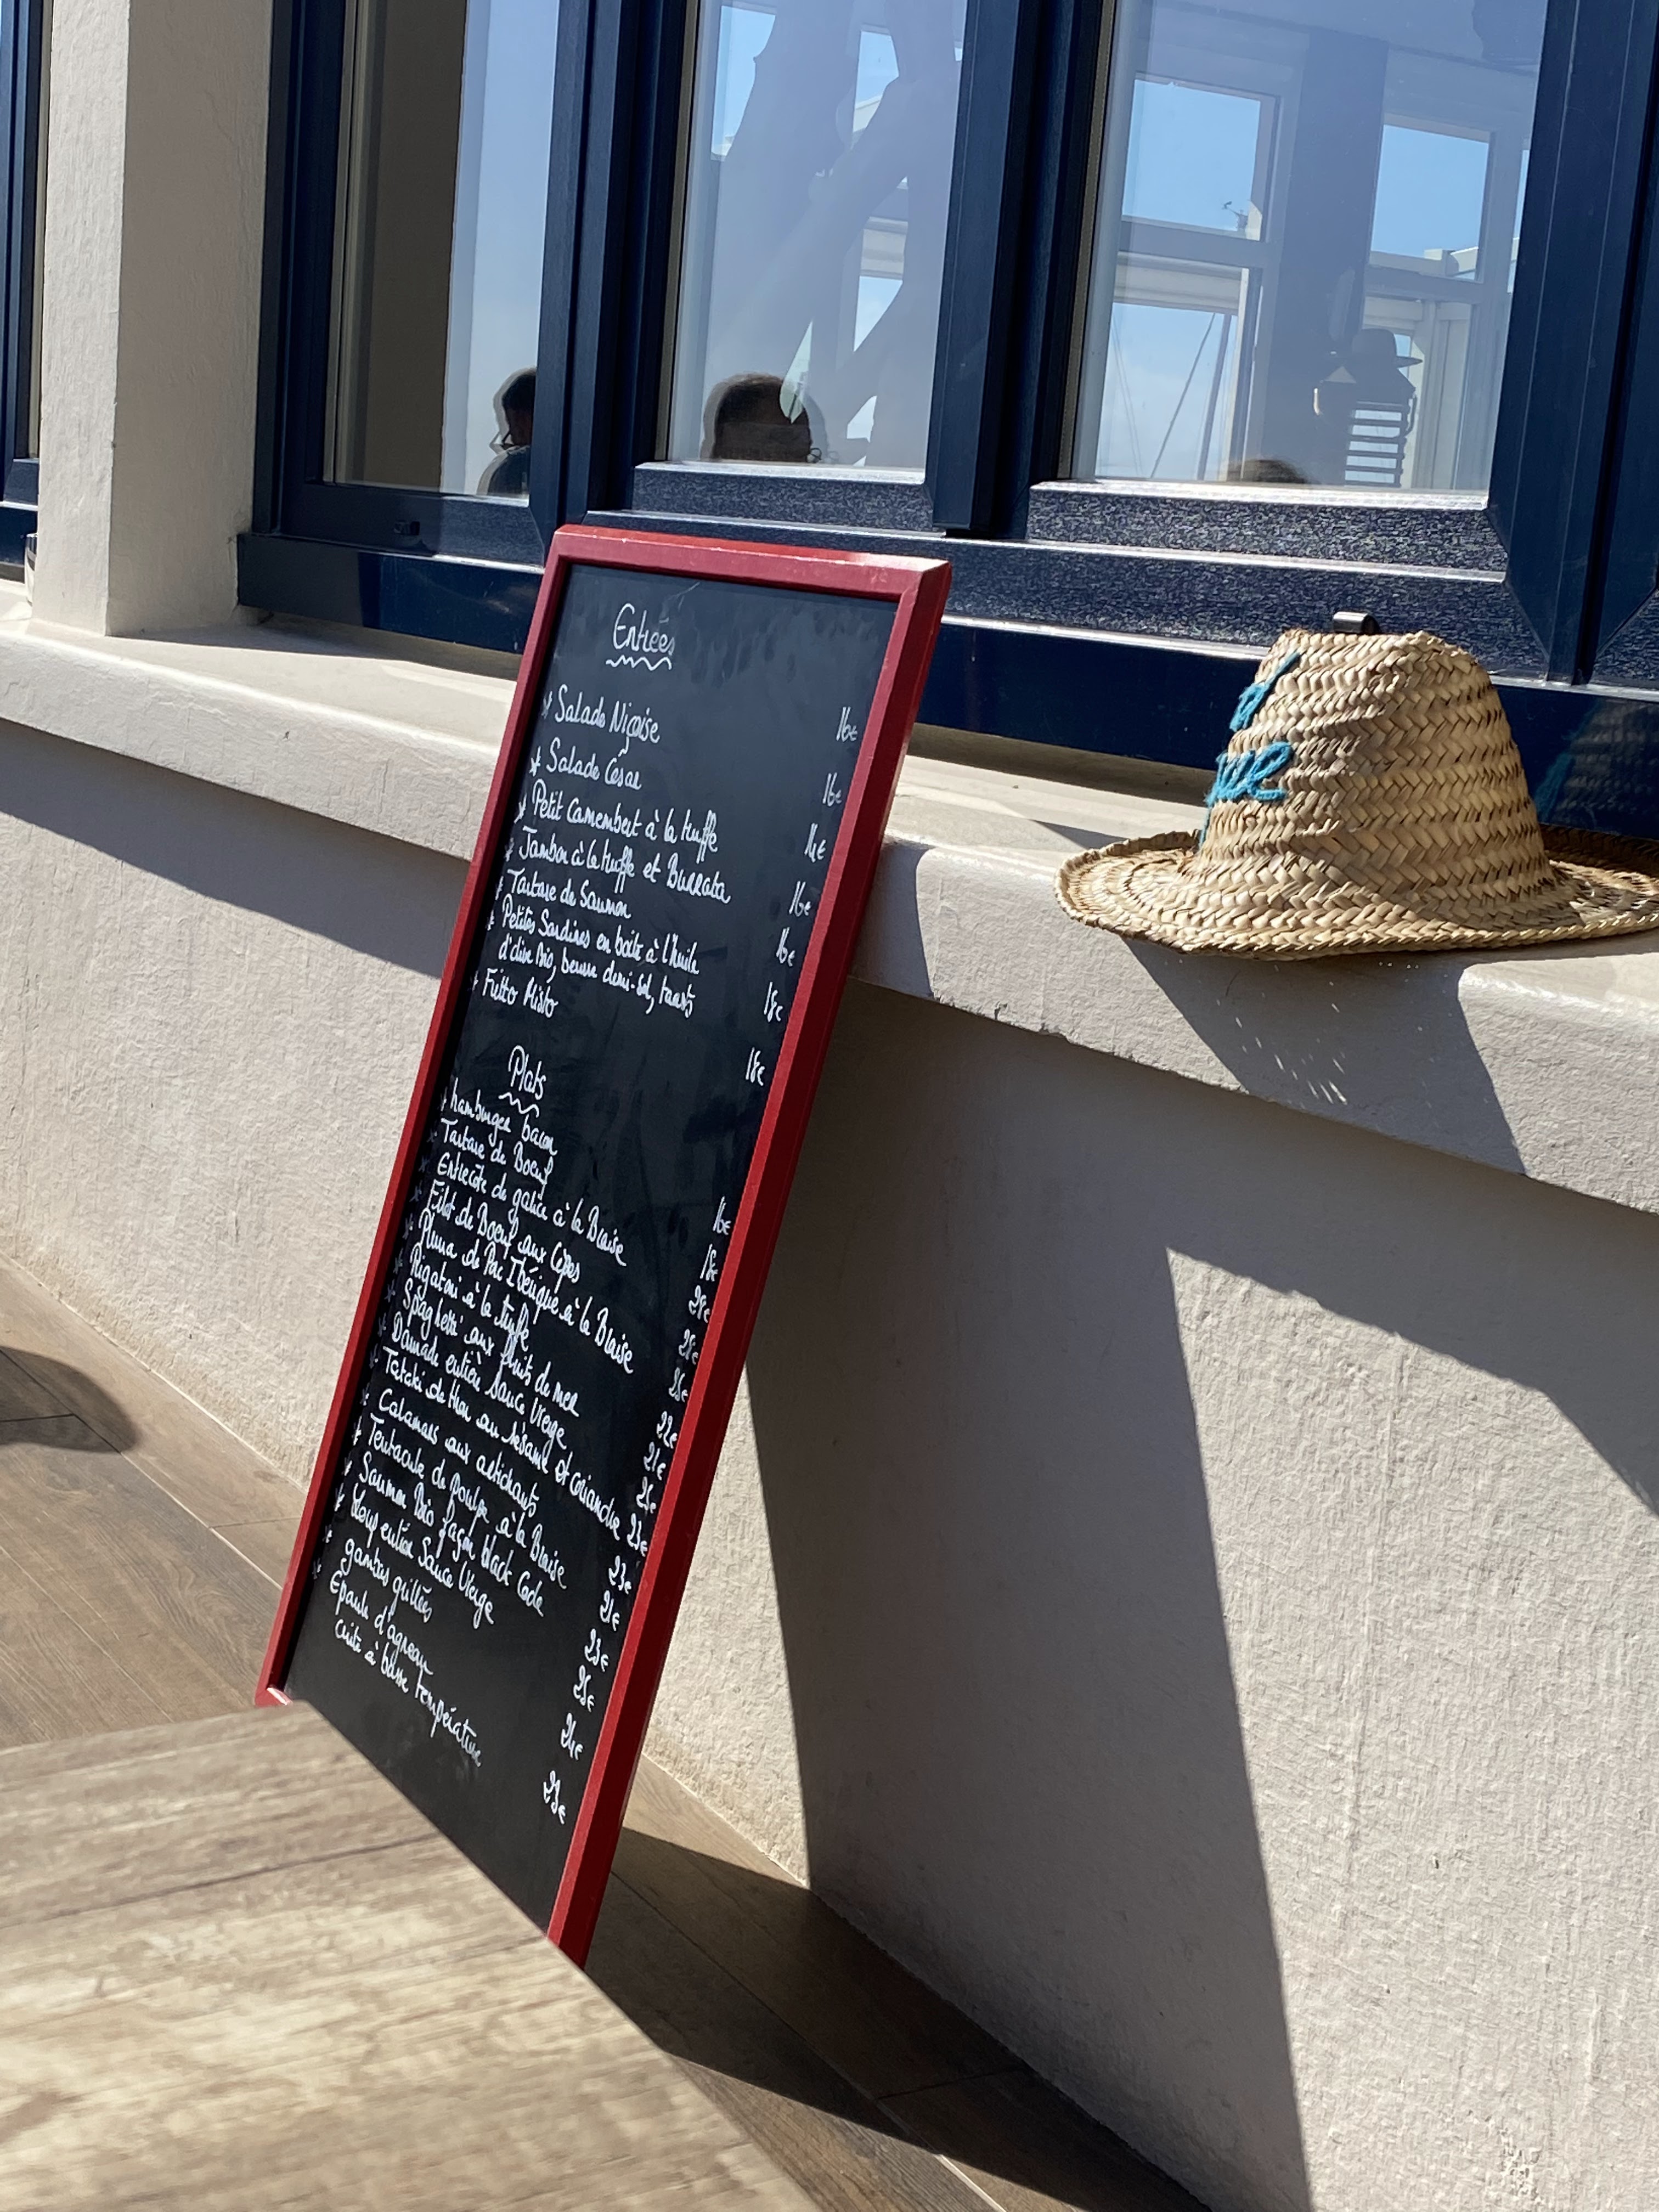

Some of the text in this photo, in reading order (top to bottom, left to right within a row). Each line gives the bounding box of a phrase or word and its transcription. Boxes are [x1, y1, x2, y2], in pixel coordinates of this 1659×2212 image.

[555, 684, 606, 728] Salade
[546, 737, 600, 781] Salade
[532, 778, 563, 821] Petit
[567, 797, 641, 838] Camembert
[645, 809, 659, 841] à
[664, 808, 677, 843] la
[681, 808, 718, 863] truffe
[507, 867, 557, 901] Tartare
[560, 878, 577, 907] de
[579, 879, 631, 918] Saumon
[518, 825, 568, 865] Jambon
[571, 840, 584, 867] à
[586, 838, 600, 870] la
[601, 838, 635, 893] truffe
[643, 853, 661, 883] et
[667, 853, 731, 904] Burrata
[501, 893, 535, 934] Petites
[538, 909, 591, 948] Sardines
[596, 933, 611, 953] en
[646, 938, 659, 963] à
[482, 967, 517, 1005] Fritto
[522, 977, 558, 1018] Misto
[508, 1045, 547, 1100] Plats
[441, 1118, 485, 1160] Tartare
[490, 1140, 506, 1165] de
[514, 1141, 554, 1199] Boeuf
[426, 1178, 456, 1221] Filet
[455, 1197, 474, 1231] de
[477, 1201, 519, 1260] Boeuf
[517, 1234, 548, 1263] aux
[491, 1172, 507, 1201] de
[553, 1202, 571, 1228] à
[571, 1198, 584, 1235] la
[586, 1205, 627, 1267] Braise
[410, 1242, 462, 1301] Rigatoni
[462, 1282, 481, 1309] à
[481, 1284, 492, 1318] la
[418, 1208, 458, 1259] Pluma
[462, 1238, 480, 1269] de
[559, 1297, 580, 1327] à
[579, 1296, 593, 1336] la
[403, 1277, 464, 1341] Spaghetti
[464, 1327, 494, 1357] aux
[535, 1361, 551, 1397] de
[552, 1381, 579, 1417] mer
[383, 1346, 426, 1393] Tataki
[425, 1378, 445, 1403] de
[476, 1414, 499, 1438] au
[555, 1451, 573, 1486] et
[445, 1436, 471, 1464] aux
[359, 1451, 407, 1509] Saumon
[432, 1459, 446, 1489] de
[495, 1511, 515, 1538] à
[515, 1512, 527, 1548] la
[418, 1536, 454, 1589] Sauce
[364, 1640, 379, 1666] à
